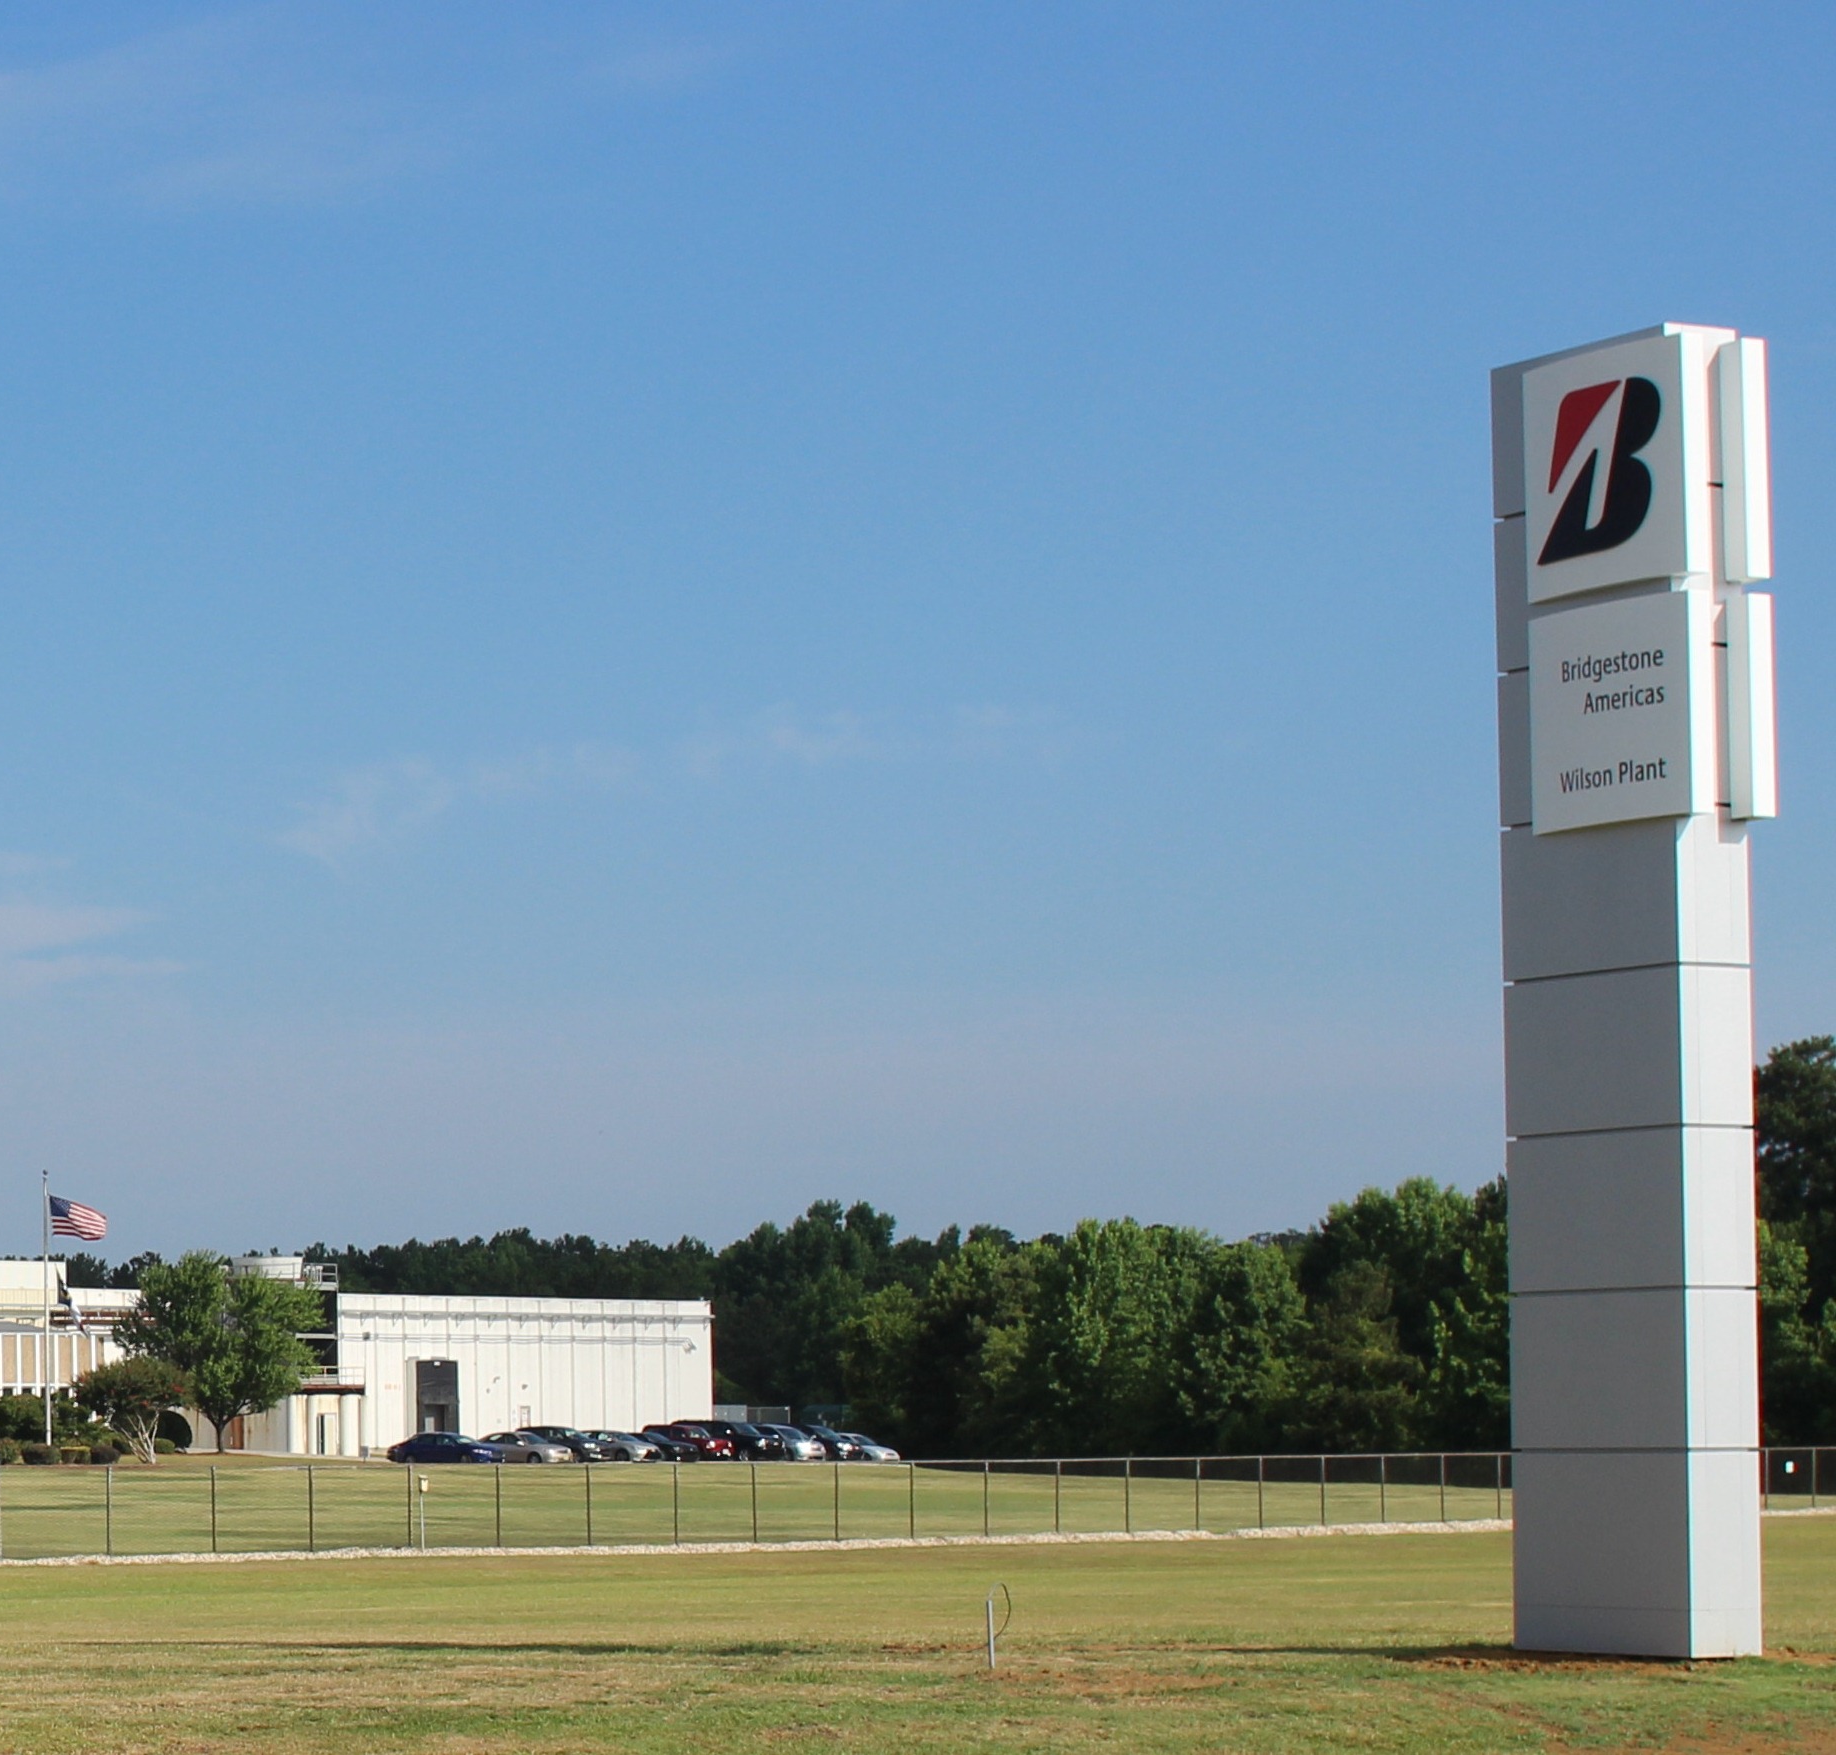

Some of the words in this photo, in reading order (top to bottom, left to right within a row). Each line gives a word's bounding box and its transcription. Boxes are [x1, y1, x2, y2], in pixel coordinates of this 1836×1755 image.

[1561, 649, 1664, 683] Bridgestone
[1583, 684, 1665, 715] Americas
[1560, 767, 1613, 794] Wilson
[1618, 757, 1667, 784] Plant
